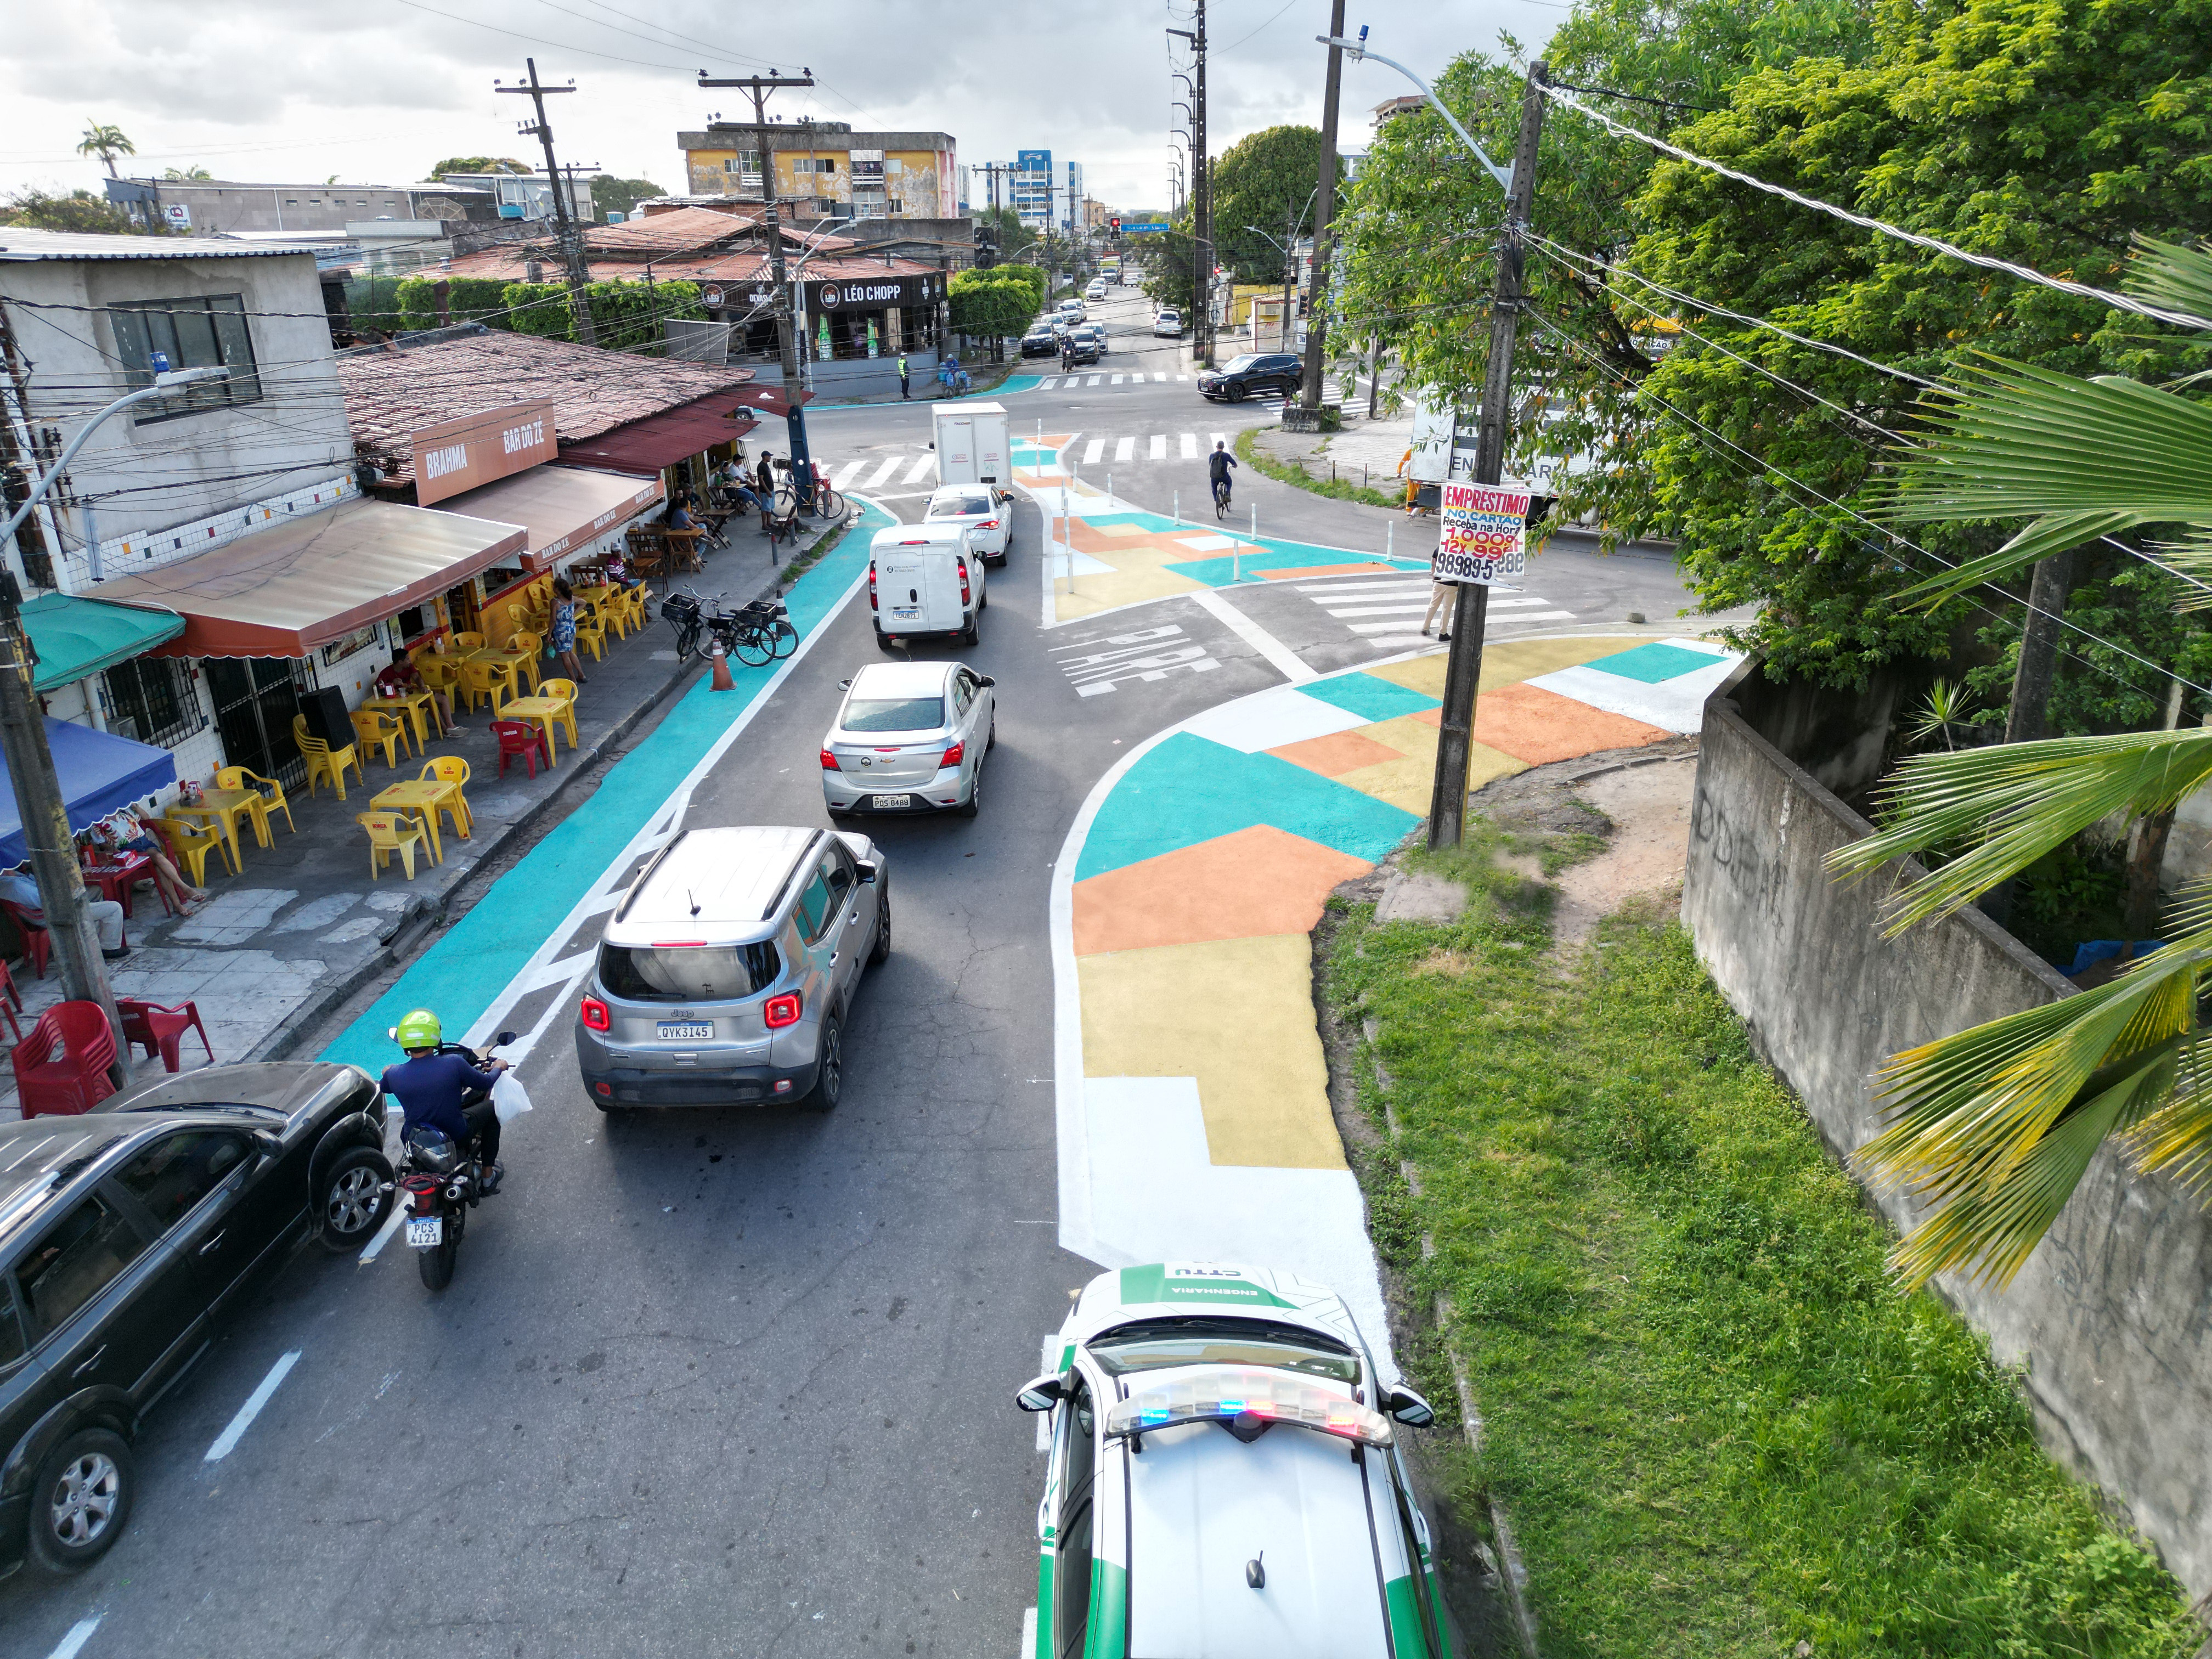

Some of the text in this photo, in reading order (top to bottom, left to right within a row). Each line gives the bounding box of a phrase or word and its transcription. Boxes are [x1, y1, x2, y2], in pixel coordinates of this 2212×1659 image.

[845, 284, 901, 302] LÉO CHOPP
[503, 415, 544, 454] BAR DO ZÉ
[426, 443, 467, 479] BRAHMA
[635, 493, 644, 504] BAR
[1445, 486, 1529, 516] EMPRÉSTIMO
[594, 517, 604, 529] BAR
[603, 514, 610, 524] DO
[1443, 516, 1521, 534] Receba na Hora
[1447, 509, 1522, 526] NO CARTÃO
[541, 547, 553, 559] BAR
[554, 542, 562, 553] DO
[1047, 624, 1223, 698] PARE
[670, 1009, 695, 1018] Jeep
[662, 1027, 708, 1037] QYK3I45
[414, 1223, 434, 1233] PCS
[1171, 1288, 1258, 1296] ENGENHARIA
